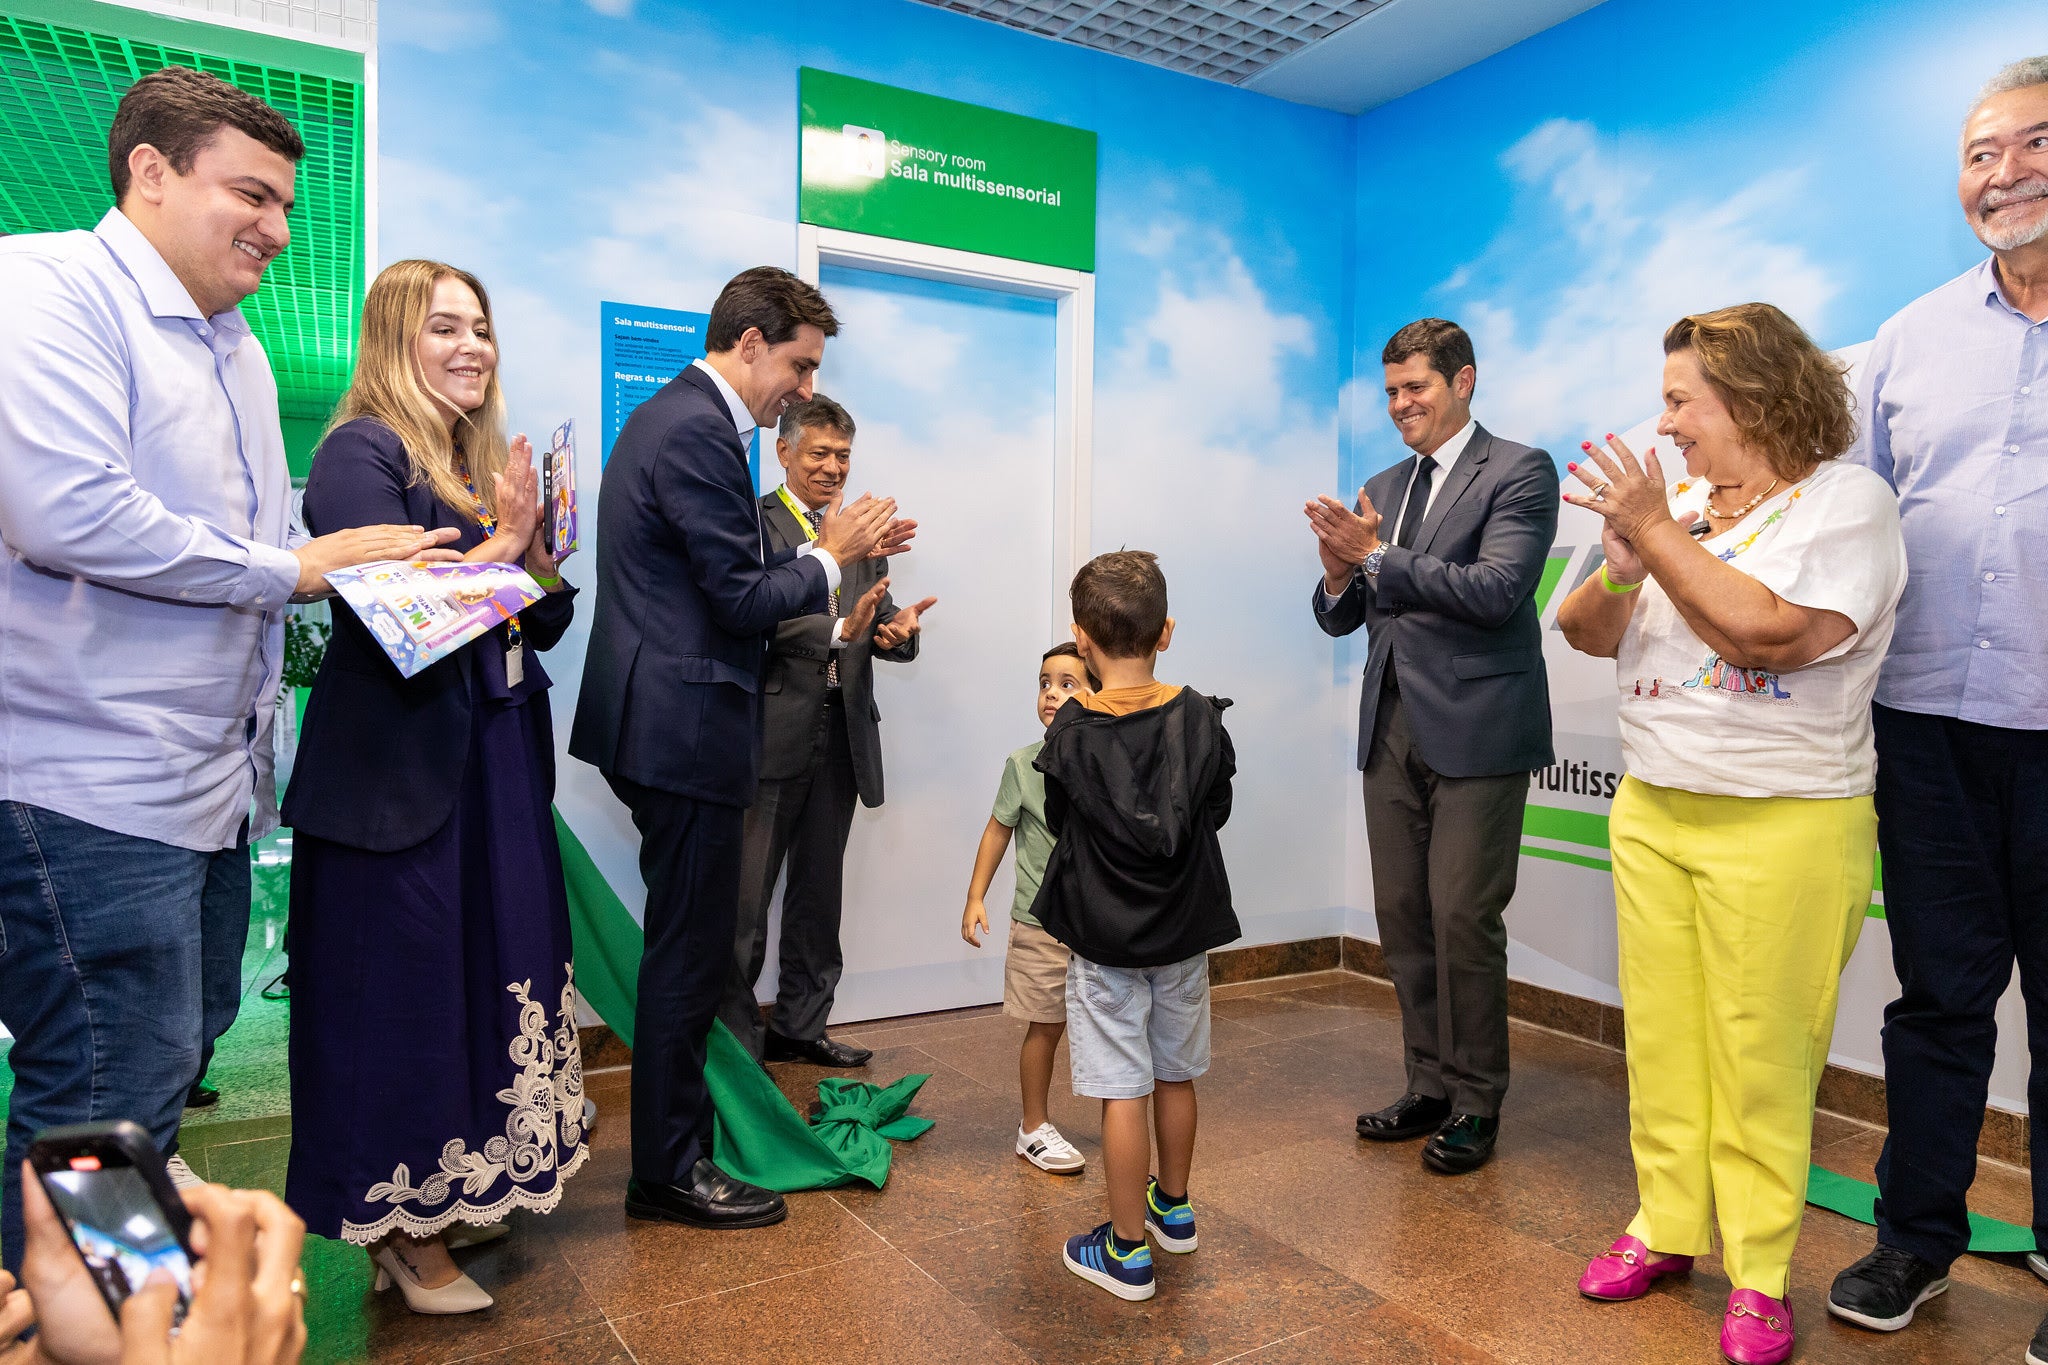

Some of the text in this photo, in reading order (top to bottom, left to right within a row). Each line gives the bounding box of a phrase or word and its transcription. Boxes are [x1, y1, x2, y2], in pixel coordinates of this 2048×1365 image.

[890, 139, 986, 172] Sensory room
[890, 159, 1061, 207] Sala multissensorial
[614, 317, 695, 333] Sala multissensorial
[615, 371, 643, 382] Regras
[644, 374, 655, 383] da
[1530, 759, 1624, 799] Multiss
